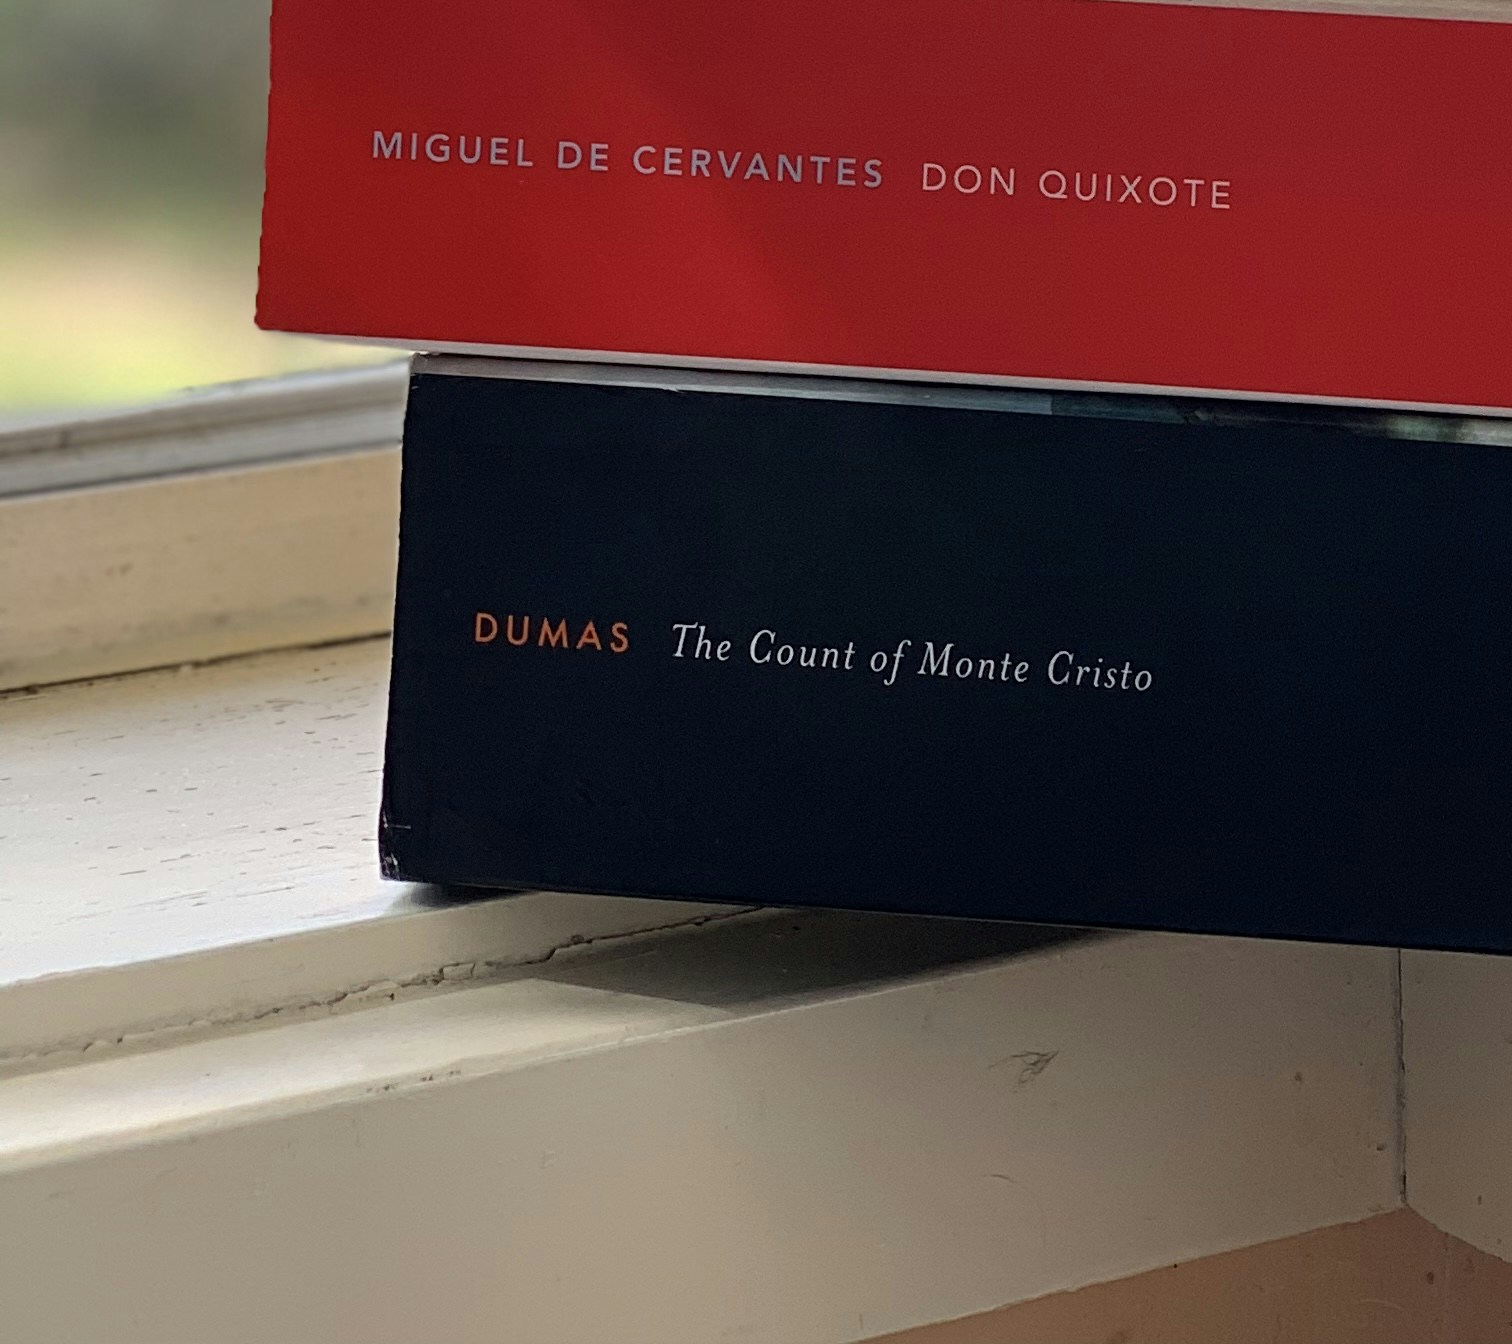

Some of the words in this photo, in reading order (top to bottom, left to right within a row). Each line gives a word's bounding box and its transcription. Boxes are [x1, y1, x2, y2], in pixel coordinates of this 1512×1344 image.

[372, 130, 534, 167] MIGUEL
[557, 141, 609, 171] DE
[632, 145, 882, 188] CERVANTES
[922, 162, 1015, 196] DON
[1039, 170, 1231, 209] QUIXOTE
[475, 612, 629, 653] DUMAS
[672, 621, 732, 661] The
[749, 629, 856, 670] Count
[870, 639, 912, 686] of
[917, 641, 1029, 683] Monte
[1047, 650, 1152, 691] Cristo
